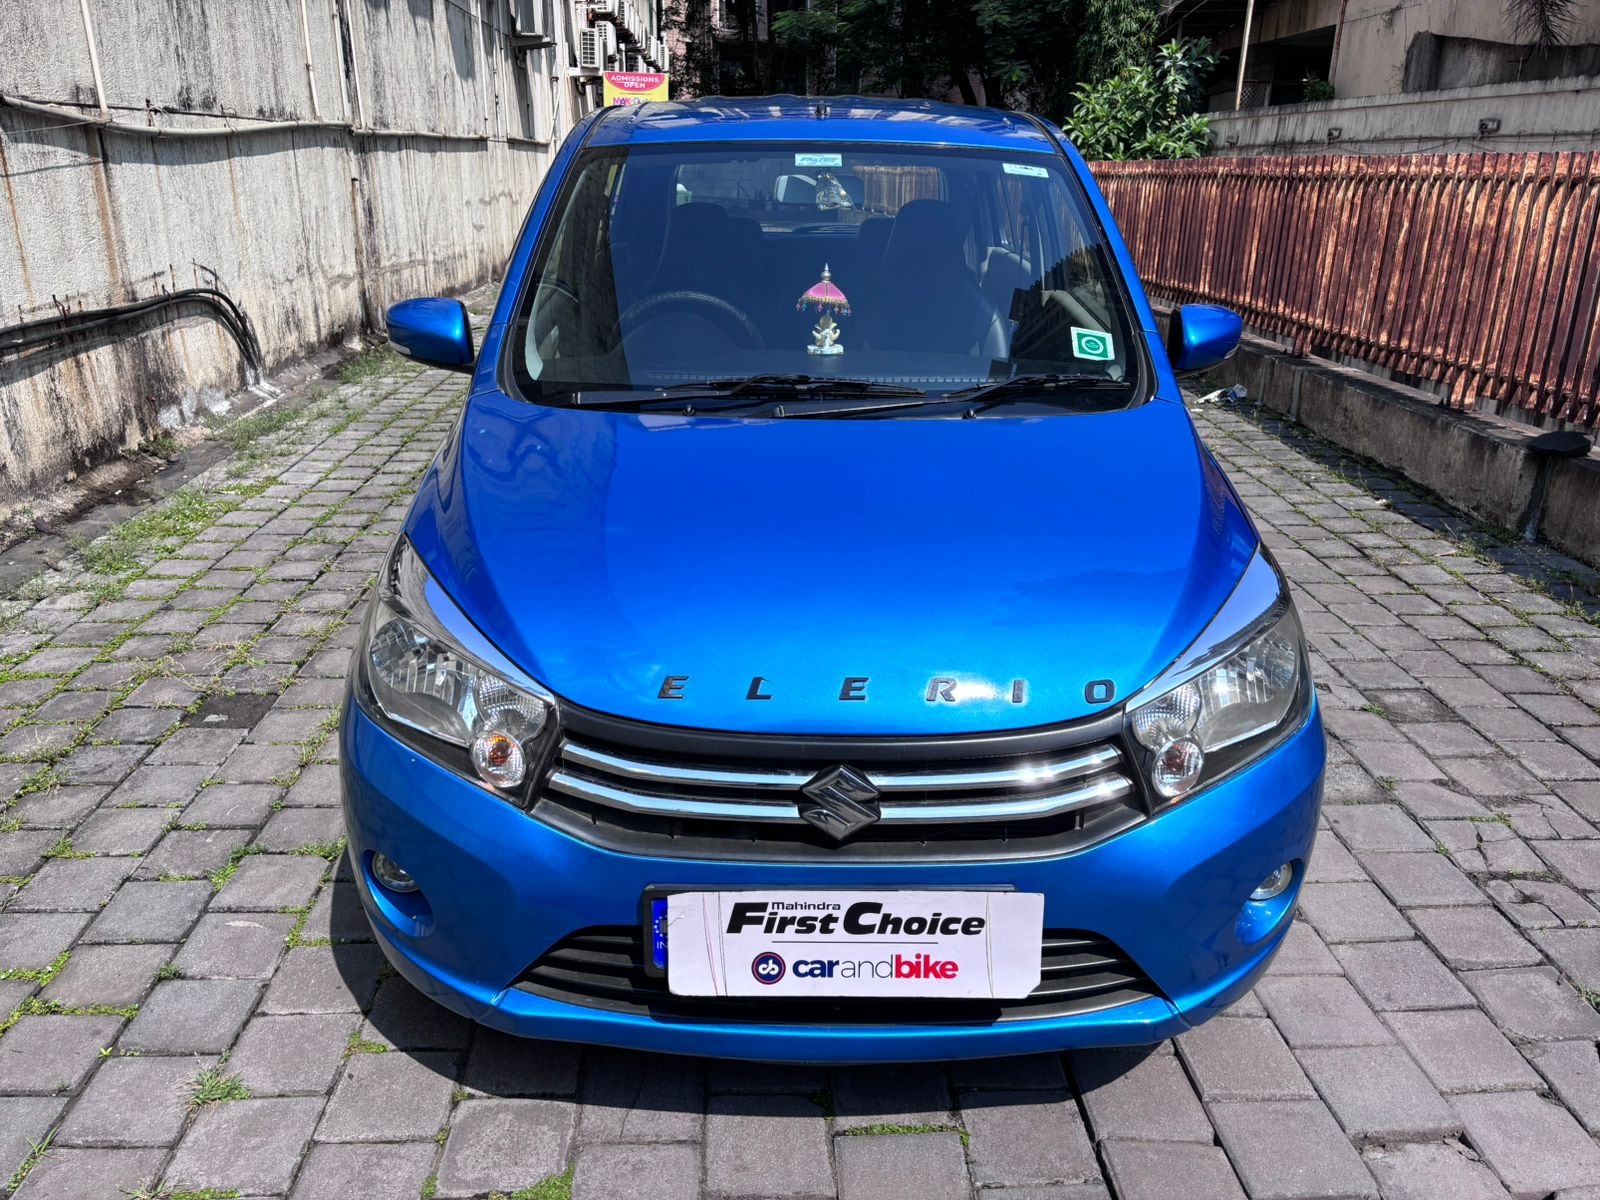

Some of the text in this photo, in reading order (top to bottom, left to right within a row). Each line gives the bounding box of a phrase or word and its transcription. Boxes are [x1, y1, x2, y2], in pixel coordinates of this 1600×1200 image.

[611, 75, 659, 83] ADMISSIONS
[771, 901, 841, 911] Mahindra
[726, 901, 986, 936] First Choice
[792, 953, 959, 980] carandbike
